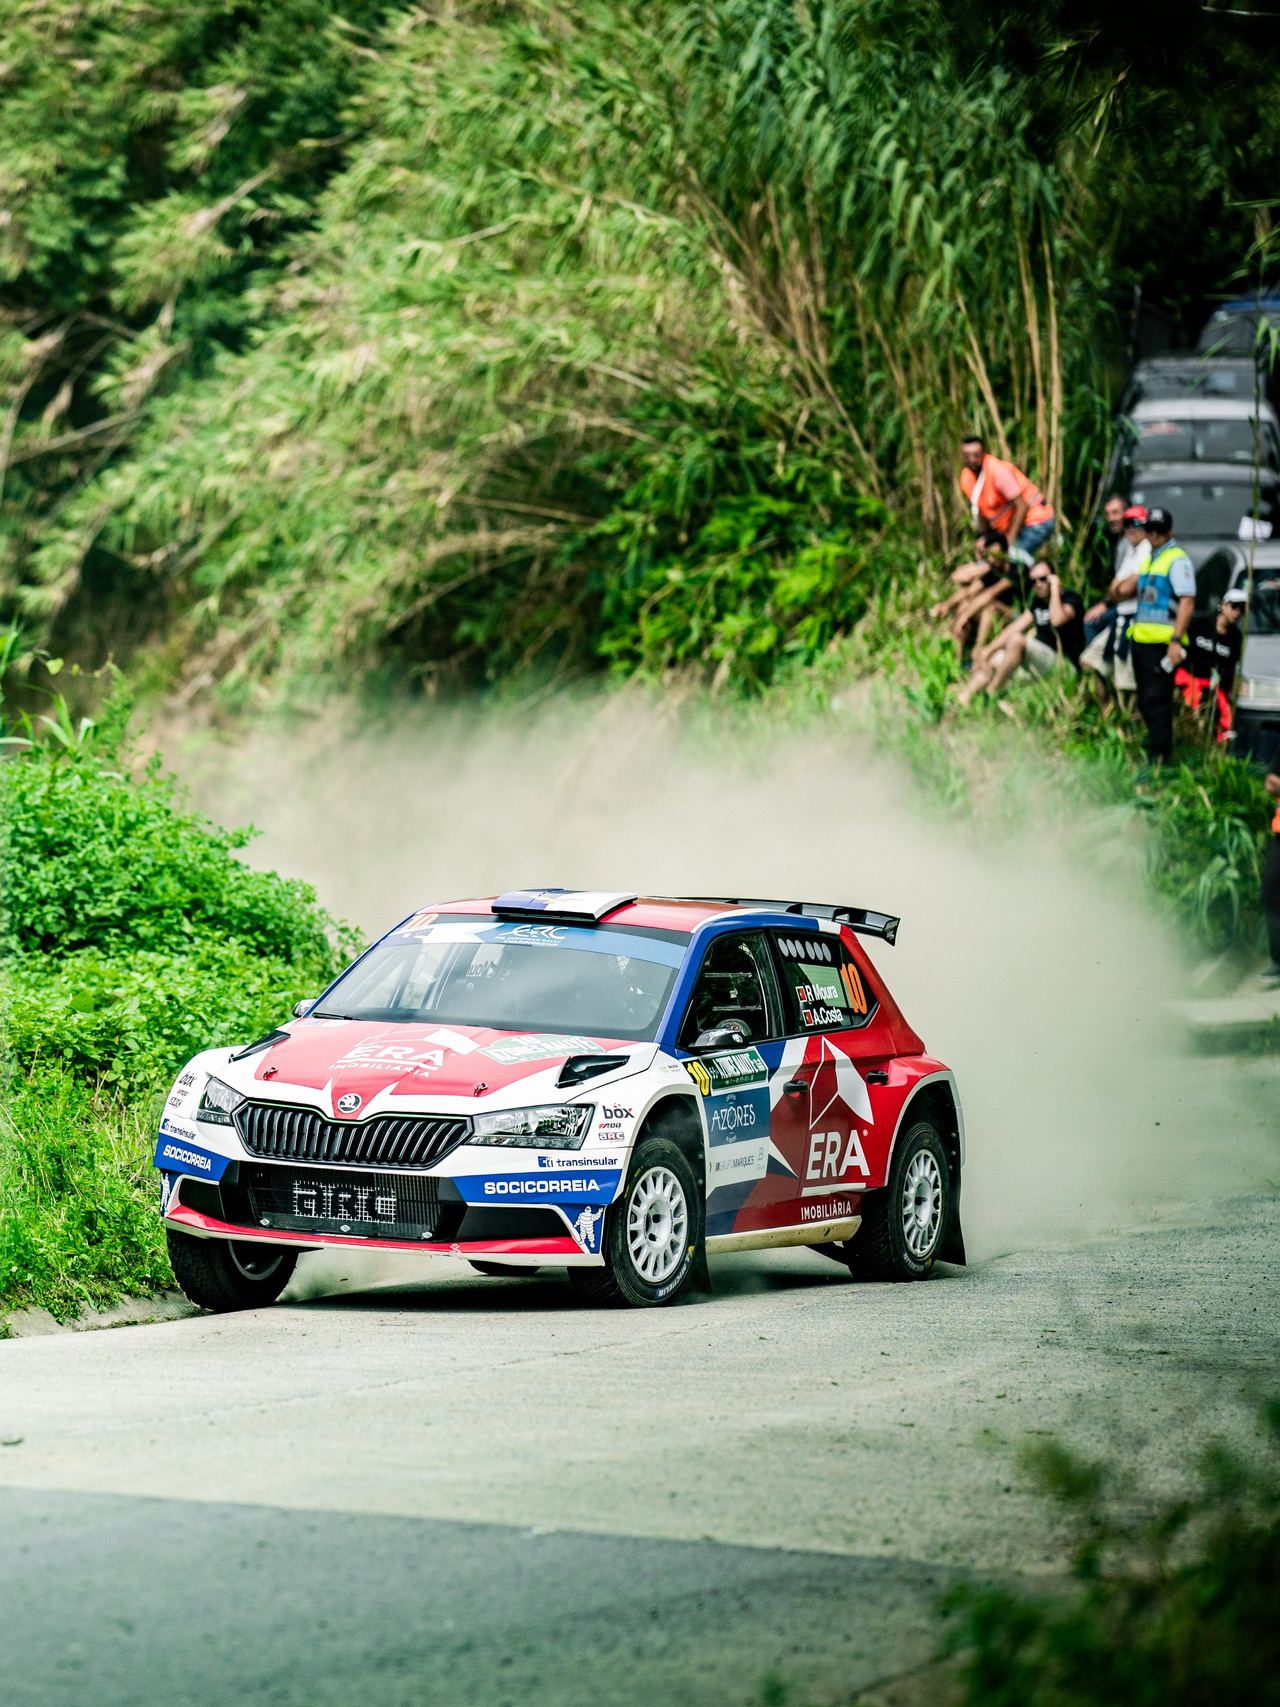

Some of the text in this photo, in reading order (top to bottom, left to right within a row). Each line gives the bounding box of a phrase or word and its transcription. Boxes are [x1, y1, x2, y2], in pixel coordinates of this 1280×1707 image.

[499, 922, 568, 939] ERC
[840, 962, 868, 1014] 10
[813, 1006, 844, 1025] A.Costa
[510, 1036, 541, 1045] 10
[539, 1036, 598, 1051] RALLYE
[342, 1045, 445, 1067] ERA
[178, 1071, 195, 1087] box
[686, 1060, 710, 1096] 10
[602, 1103, 635, 1119] box
[711, 1104, 756, 1132] AZORES
[170, 1124, 196, 1141] transinsular
[163, 1144, 212, 1172] SOCICORREIA
[556, 1156, 618, 1168] transinsular
[806, 1129, 871, 1180] ERA
[483, 1178, 601, 1195] SOCICORREIA
[800, 1199, 852, 1221] IMOBILIÁRIA
